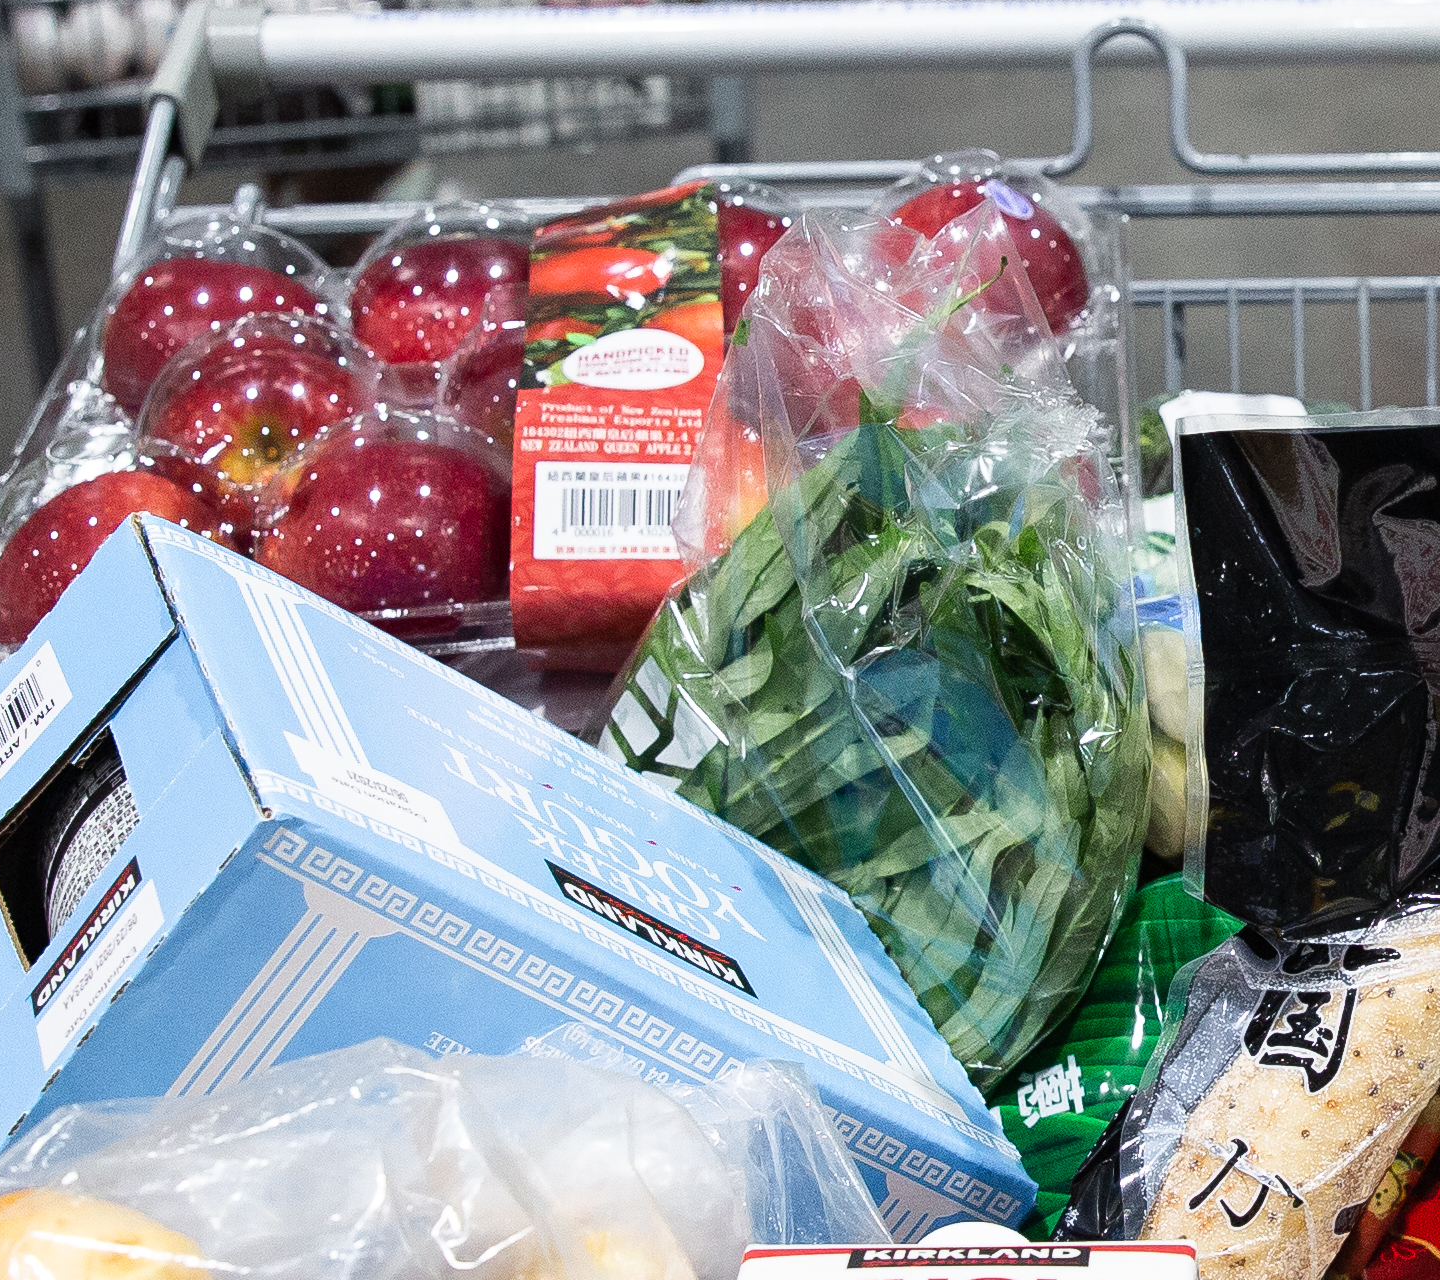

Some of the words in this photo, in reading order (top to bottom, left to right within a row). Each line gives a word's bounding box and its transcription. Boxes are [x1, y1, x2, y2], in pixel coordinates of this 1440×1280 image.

[579, 347, 689, 362] HANDPICKED
[542, 403, 592, 413] Product
[650, 406, 702, 417] Zealand
[613, 415, 670, 427] Exports
[520, 439, 543, 452] NEW
[548, 440, 599, 452] ZEALAND
[603, 441, 640, 454] QUEEN
[29, 697, 55, 731] ITM.
[404, 704, 453, 739] FREE
[456, 732, 533, 782] GLUTEN
[559, 789, 635, 837] NONFAT
[442, 742, 767, 942] YOGURT
[514, 812, 720, 941] GREEK
[663, 845, 721, 883] PLAIN
[31, 872, 139, 1010] KIRKLAND
[563, 881, 745, 989] KIRKLAND
[87, 944, 137, 1009] Expiration
[63, 1007, 87, 1040] Date
[423, 1030, 471, 1057] REE
[862, 1248, 1082, 1262] KIRKLAND
